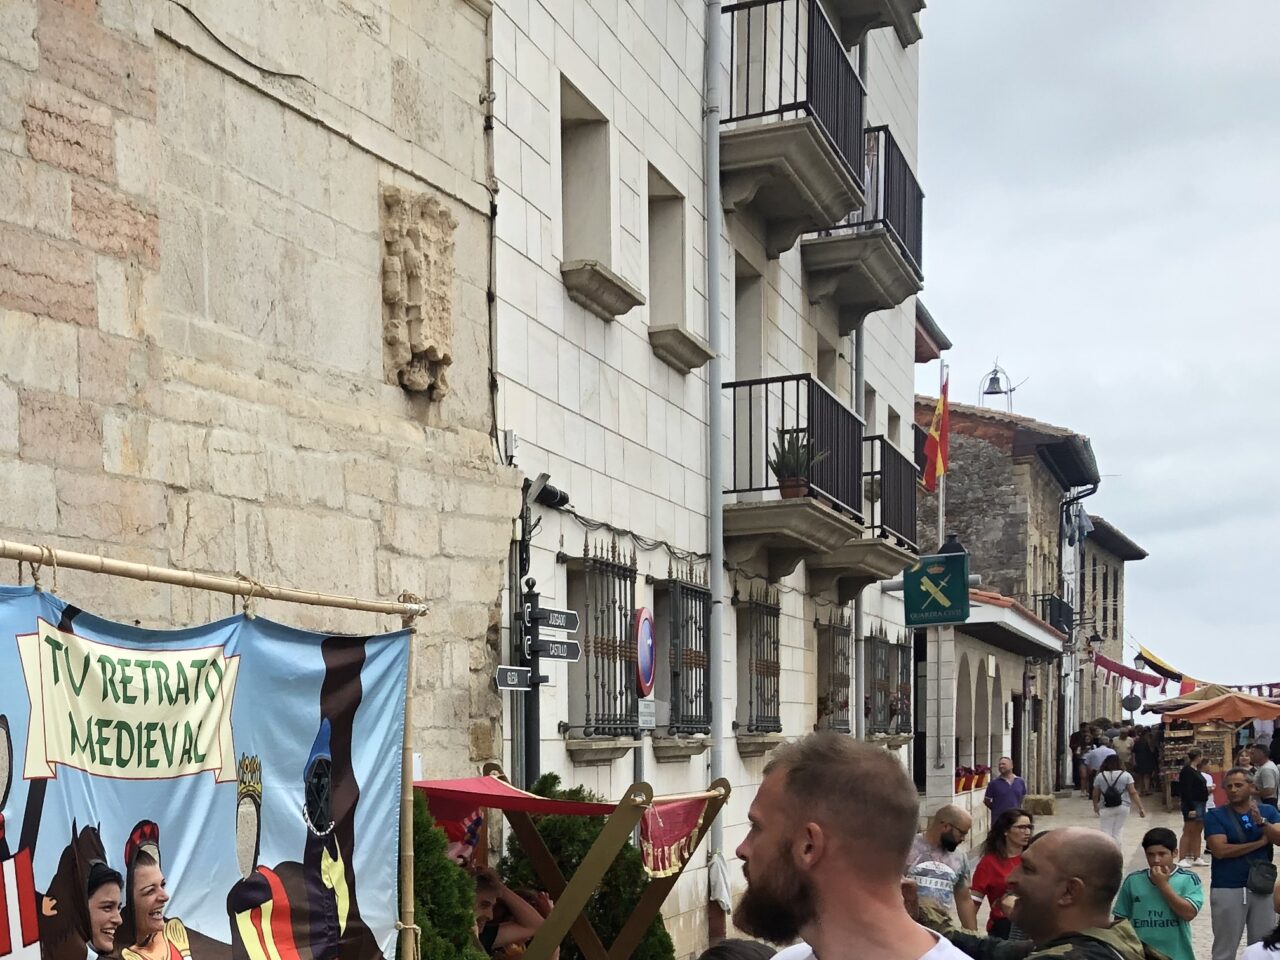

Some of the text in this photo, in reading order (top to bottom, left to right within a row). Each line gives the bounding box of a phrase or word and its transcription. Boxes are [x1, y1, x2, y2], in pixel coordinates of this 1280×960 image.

[549, 643, 567, 656] CASTILLO
[44, 634, 224, 706] TU RETRATO
[68, 710, 207, 769] MEDIEVAL
[1147, 909, 1164, 919] Fly
[1133, 918, 1181, 929] Emirates
